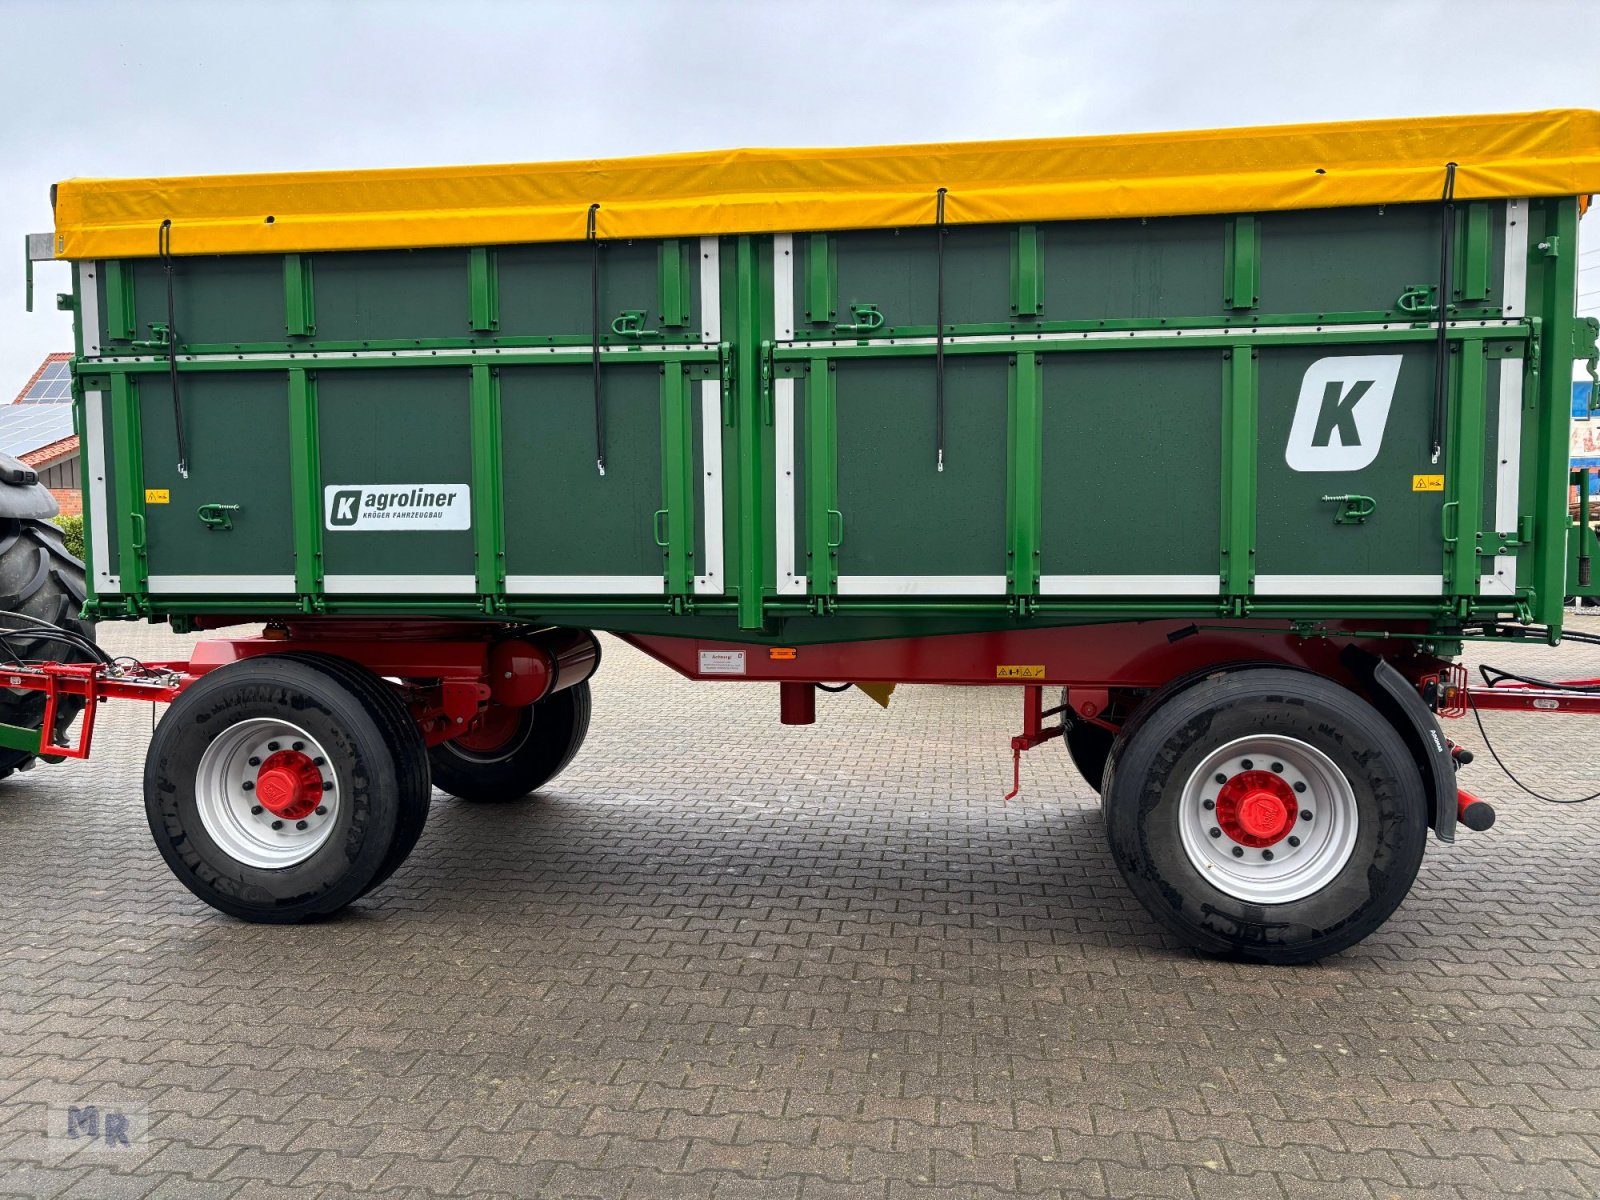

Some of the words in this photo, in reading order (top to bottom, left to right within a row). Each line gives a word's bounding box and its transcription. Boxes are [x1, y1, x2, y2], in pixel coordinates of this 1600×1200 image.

[1311, 380, 1376, 447] K
[336, 497, 355, 519] K
[364, 488, 457, 511] agroliner
[363, 511, 390, 519] KRÖGER
[392, 511, 443, 519] FAHRZEUGBAU
